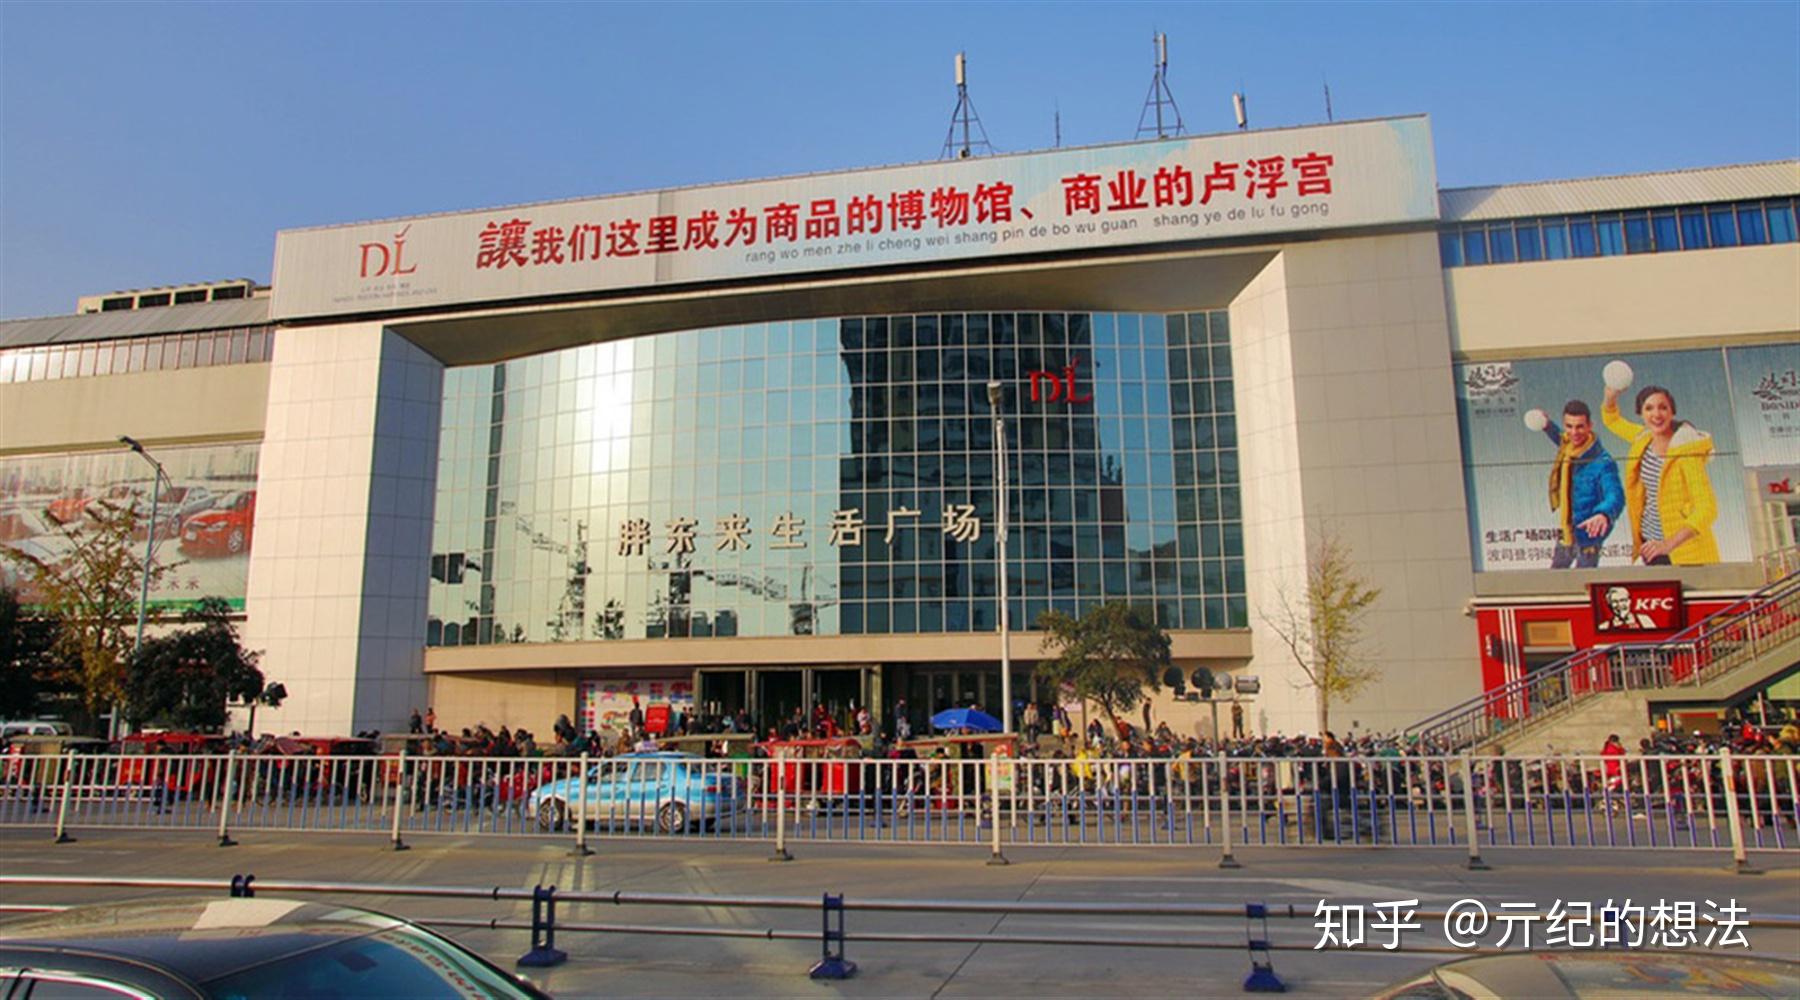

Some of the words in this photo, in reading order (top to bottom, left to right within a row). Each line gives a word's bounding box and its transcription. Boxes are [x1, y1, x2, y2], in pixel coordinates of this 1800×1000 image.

[745, 250, 776, 263] rang
[780, 248, 799, 259] wo
[803, 245, 833, 257] men
[837, 241, 862, 254] zhe
[866, 240, 875, 251] li
[878, 234, 922, 251] cheng
[926, 233, 951, 246] wei
[954, 230, 998, 243] shang
[1002, 227, 1025, 241] pin
[1028, 225, 1048, 238] de
[1052, 223, 1071, 235] bo
[1076, 222, 1097, 234] wu
[1100, 218, 1138, 234] guan
[1153, 213, 1200, 228] shang
[1204, 211, 1222, 226] ye
[1227, 208, 1246, 221] de
[1251, 206, 1265, 219] lu
[1270, 204, 1286, 217] fu
[1290, 202, 1330, 218] gong
[617, 503, 981, 557] 胖东来生活广场
[1634, 596, 1675, 611] KFC
